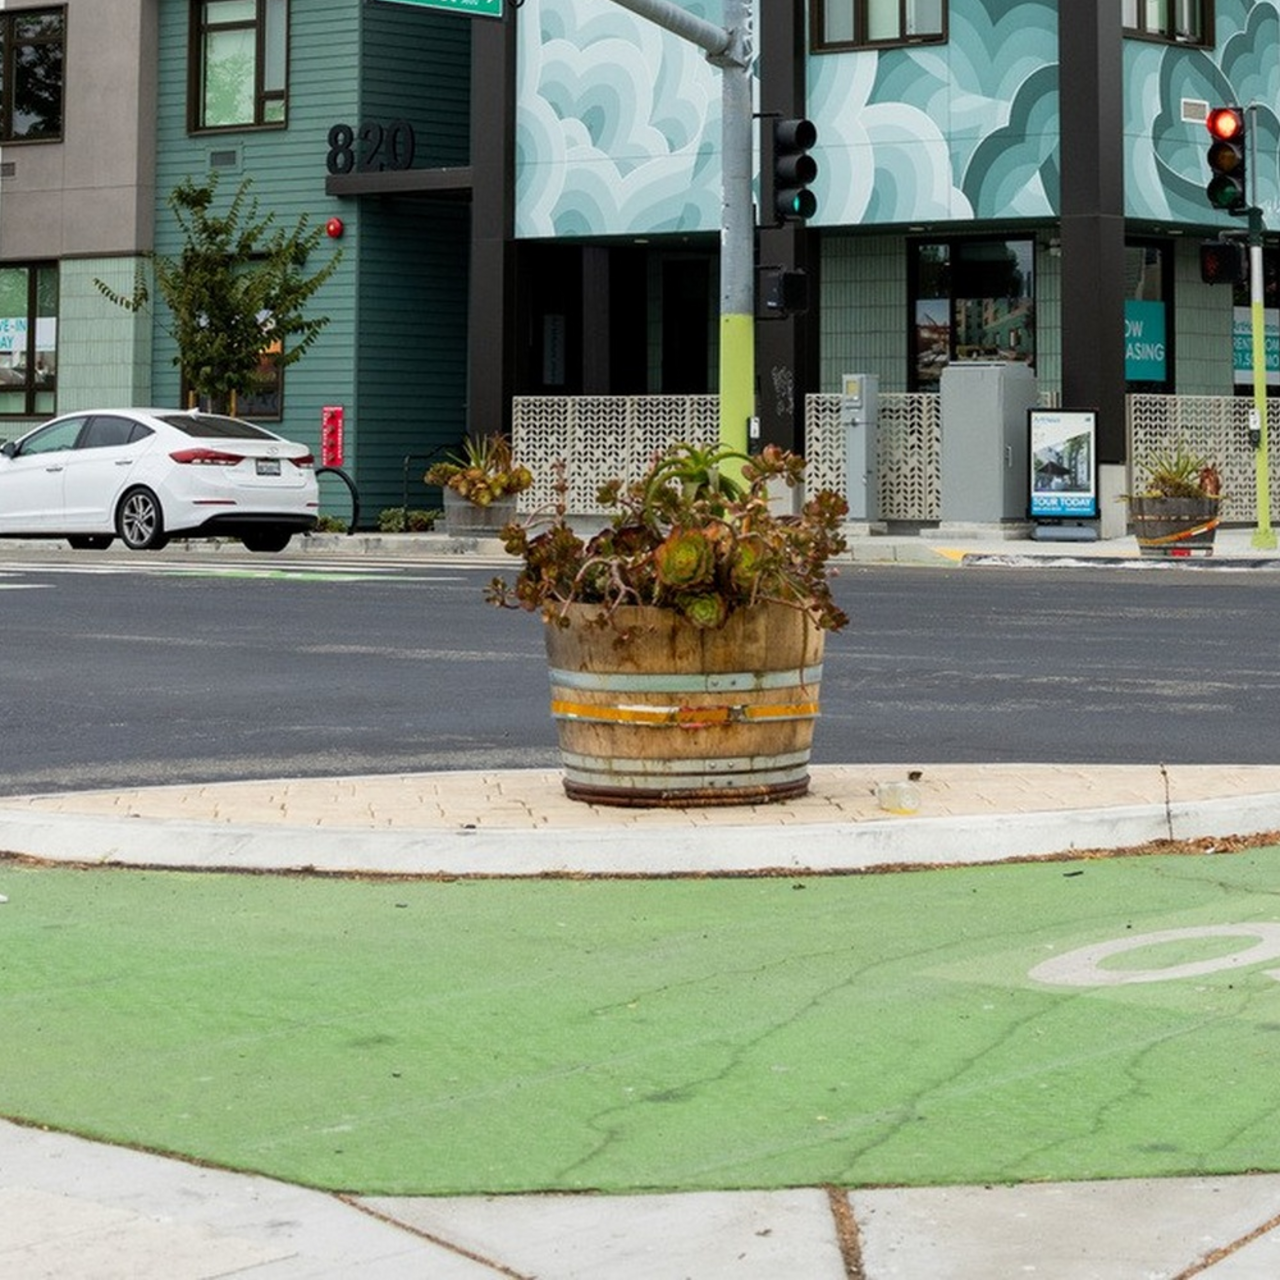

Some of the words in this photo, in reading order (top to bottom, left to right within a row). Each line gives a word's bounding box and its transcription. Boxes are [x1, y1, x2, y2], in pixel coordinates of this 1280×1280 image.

[327, 119, 415, 175] 820
[1125, 343, 1165, 362] ASING
[1033, 497, 1058, 508] TOUR
[1060, 497, 1092, 508] TODAY
